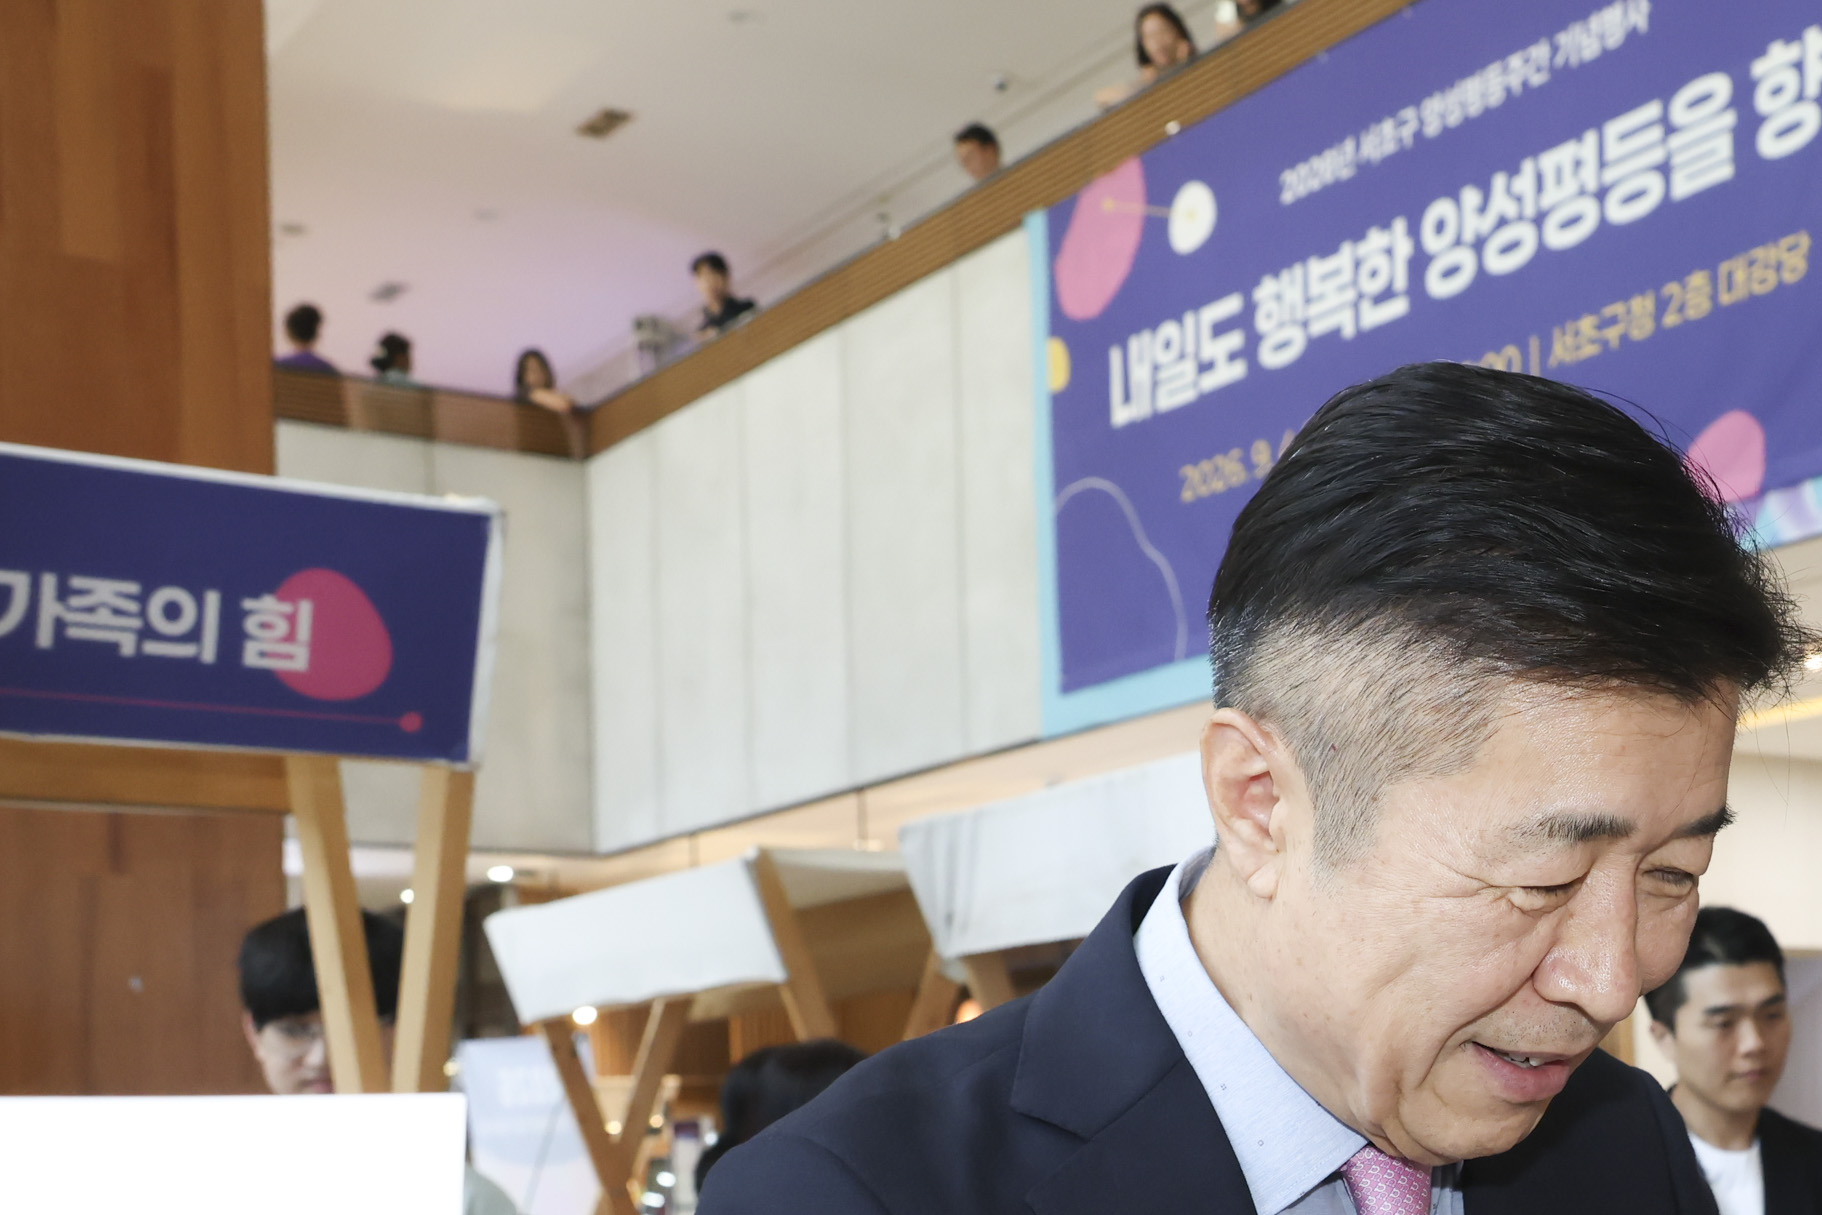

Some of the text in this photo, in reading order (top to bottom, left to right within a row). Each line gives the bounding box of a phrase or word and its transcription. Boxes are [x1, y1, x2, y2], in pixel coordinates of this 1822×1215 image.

[1108, 291, 1249, 430] 내일도
[1252, 215, 1416, 370] 행복한
[1419, 71, 1738, 301] 양성평등을
[1546, 288, 1656, 369] 서초구청
[1660, 268, 1714, 328] 2층
[1716, 229, 1813, 307] 대강당
[0, 571, 314, 673] 가족의 힘
